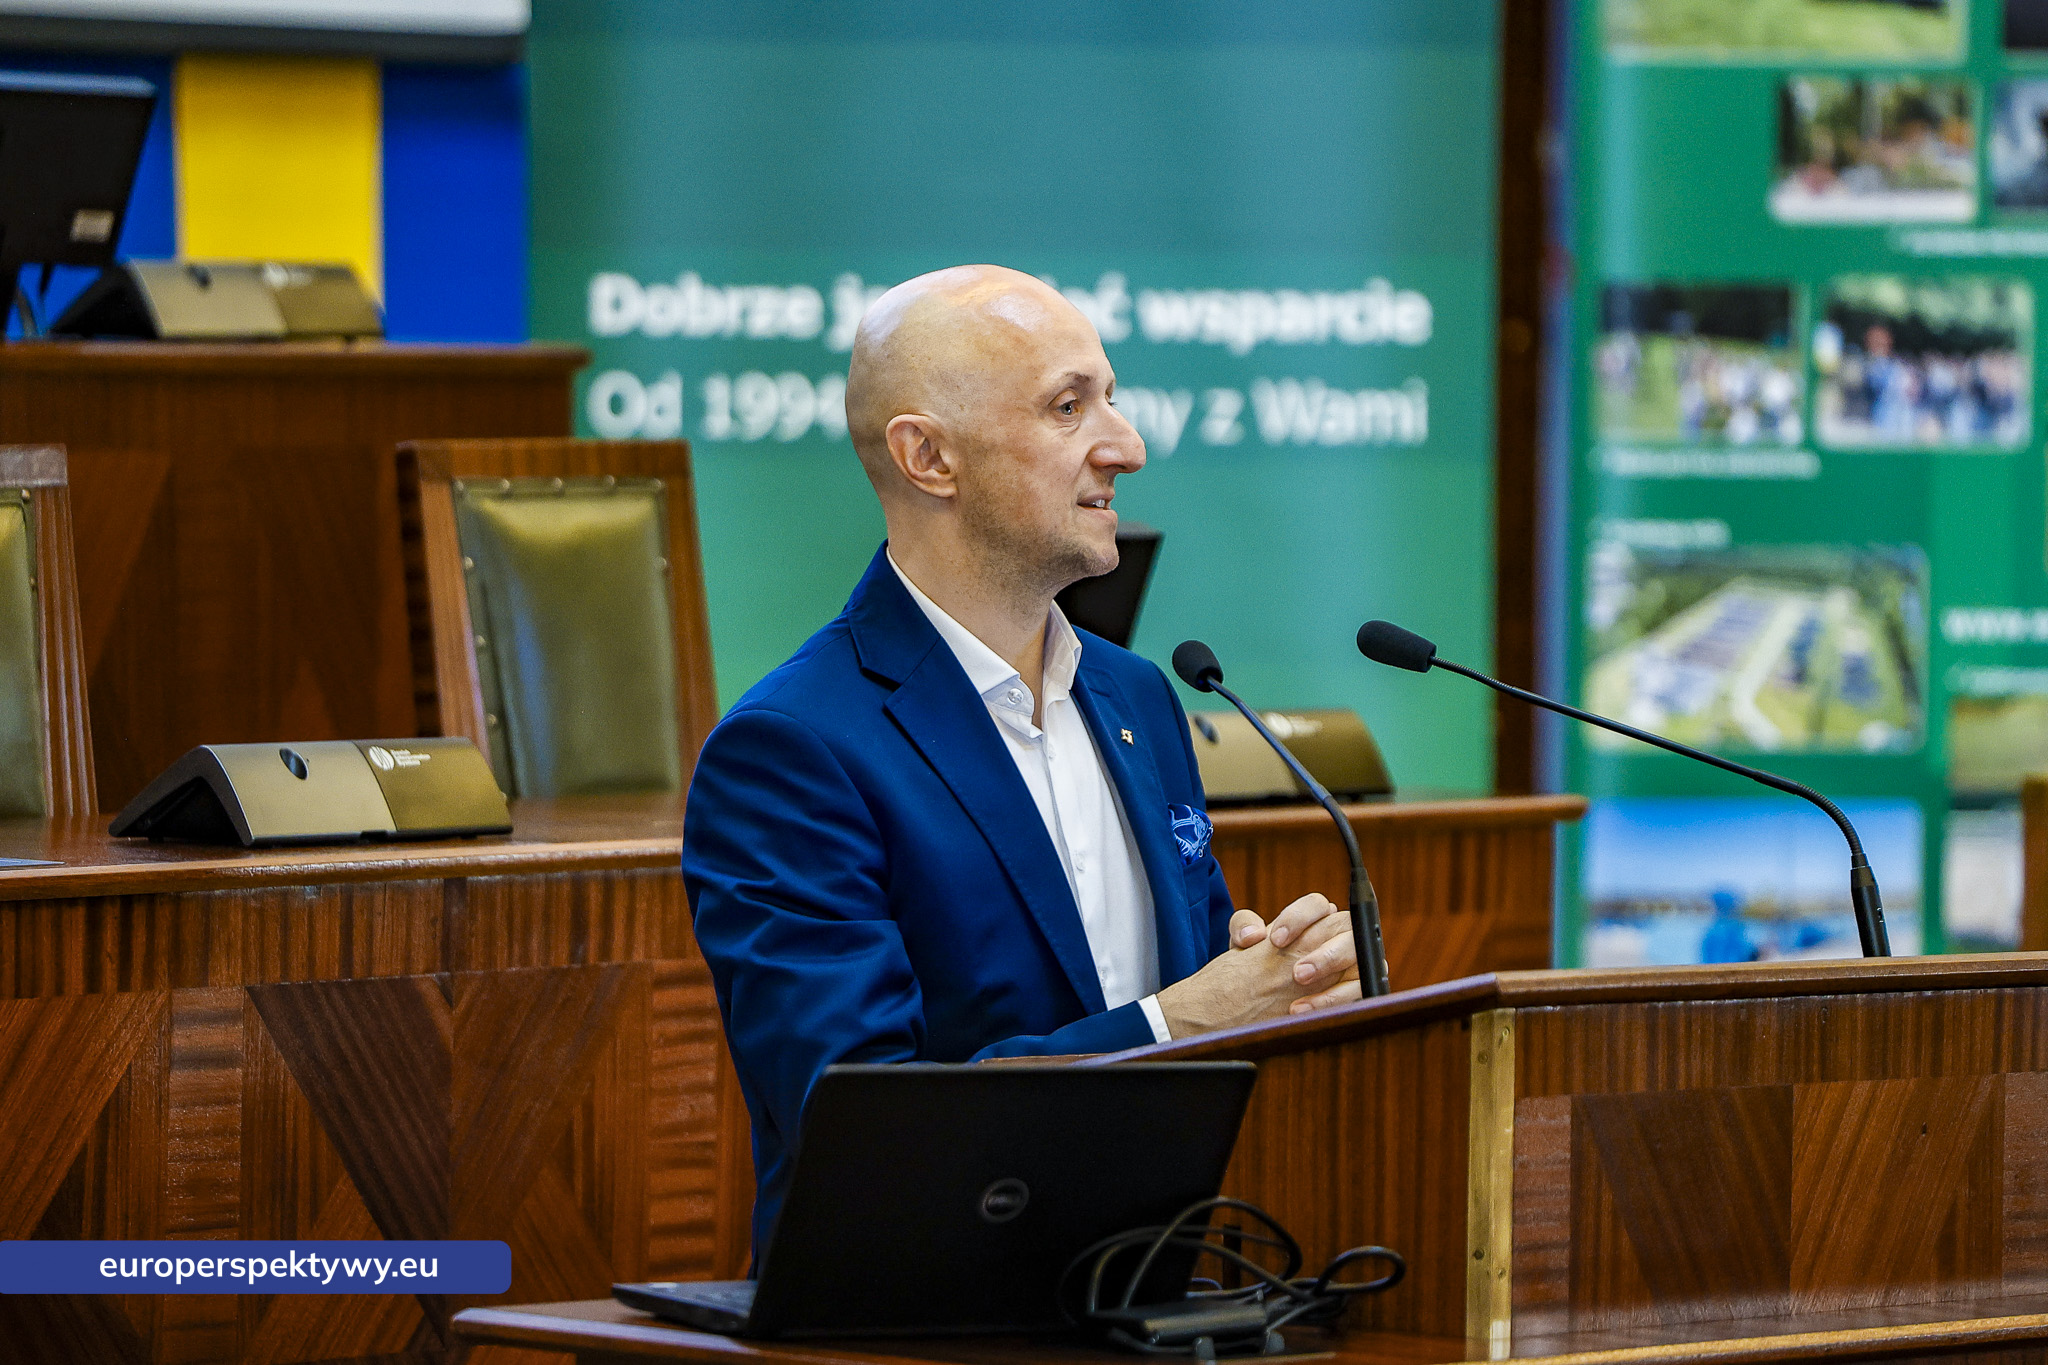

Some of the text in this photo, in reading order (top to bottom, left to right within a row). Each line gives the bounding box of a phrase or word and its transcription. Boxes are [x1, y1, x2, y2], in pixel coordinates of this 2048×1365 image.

[590, 273, 823, 337] Dobrze
[1138, 277, 1431, 353] wsparcie
[588, 371, 682, 439] Od
[1201, 388, 1242, 444] z
[1251, 378, 1428, 445] Wami
